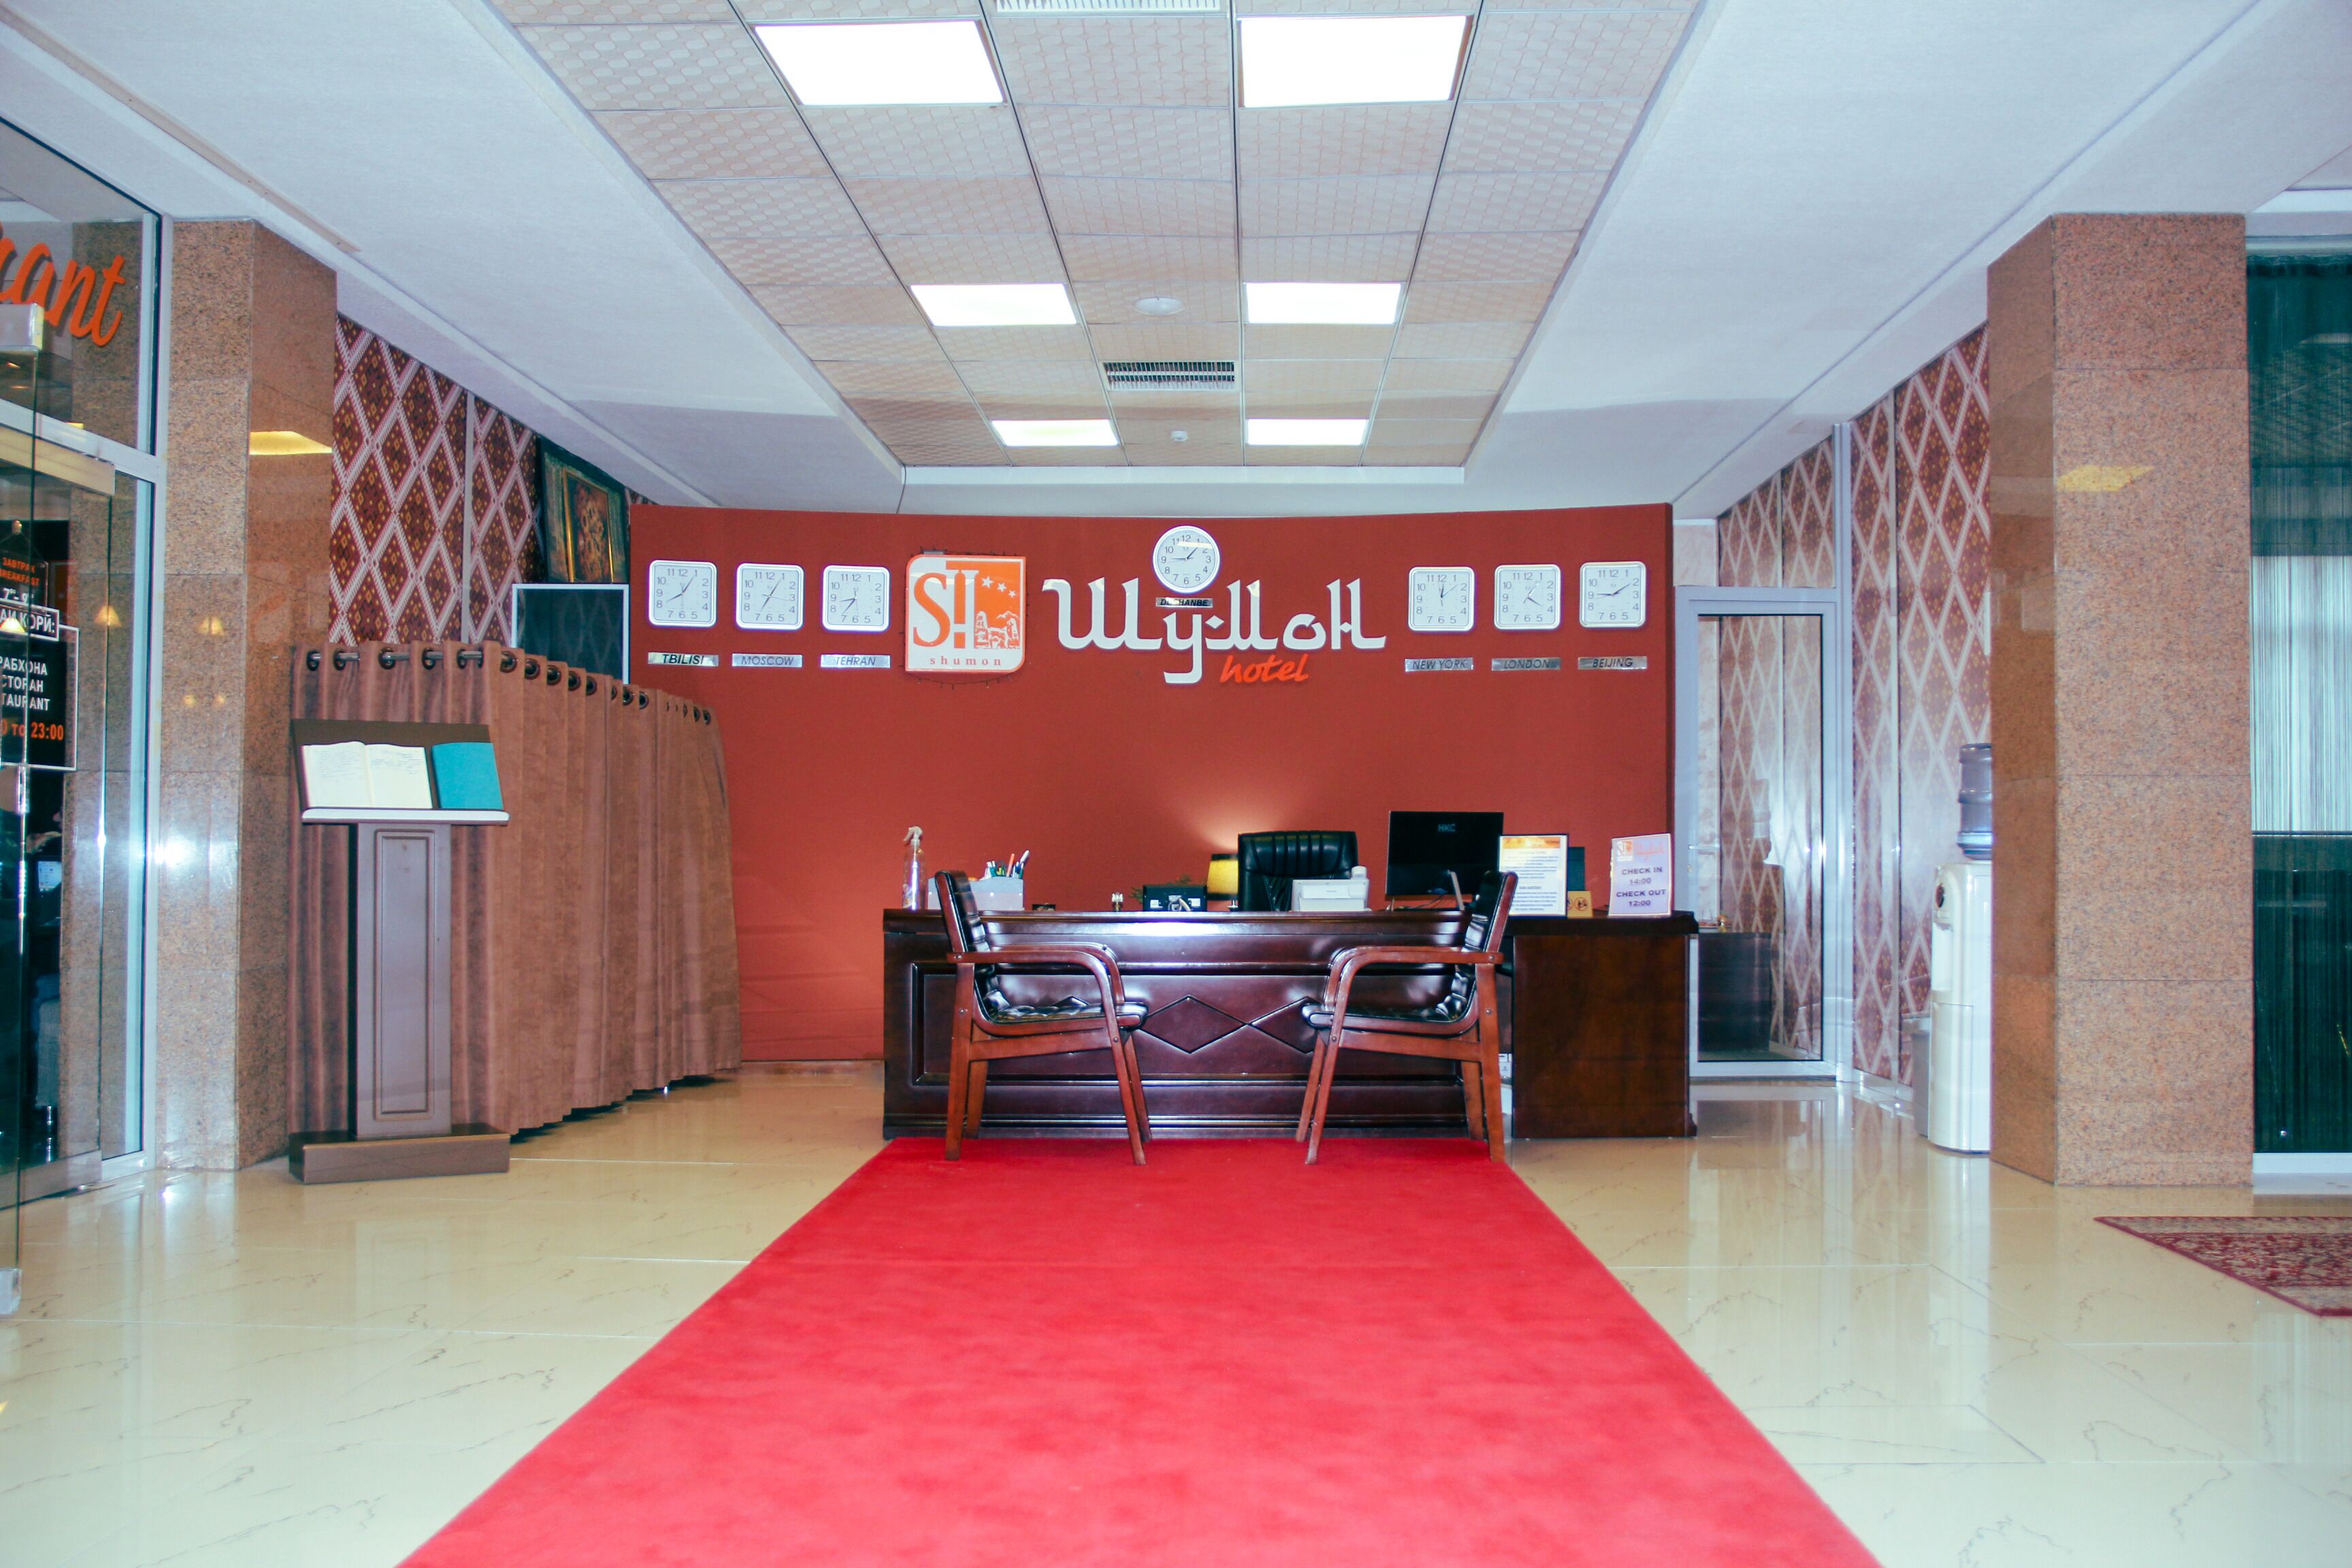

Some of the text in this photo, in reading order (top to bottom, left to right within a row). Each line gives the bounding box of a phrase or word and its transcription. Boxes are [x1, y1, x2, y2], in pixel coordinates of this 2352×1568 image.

[657, 576, 666, 585] 10
[702, 578, 708, 586] 2
[1503, 581, 1512, 589] 10
[1547, 581, 1554, 589] 2
[1589, 578, 1597, 587] 10
[1633, 578, 1639, 586] 2
[657, 589, 663, 597] 9
[744, 591, 750, 600] 9
[789, 593, 795, 602] 3
[830, 593, 836, 602] 9
[1416, 595, 1422, 603] 9
[656, 600, 663, 608] 8
[1503, 604, 1508, 612] 8
[1588, 602, 1594, 610] 8
[679, 610, 685, 619] 6
[691, 611, 698, 619] 5
[766, 613, 772, 621] 6
[1610, 612, 1616, 620] 6
[1622, 612, 1628, 620] 5
[662, 654, 704, 664] TBILISI
[741, 656, 794, 666] MOSCOW
[836, 657, 876, 666] TEHRAN
[930, 655, 1001, 666] shumon
[1592, 657, 1633, 668] BEIJING
[1220, 653, 1309, 683] hotel
[1412, 659, 1467, 670] NEW YORK
[1504, 659, 1550, 669] LONDON
[31, 721, 64, 740] 23:00
